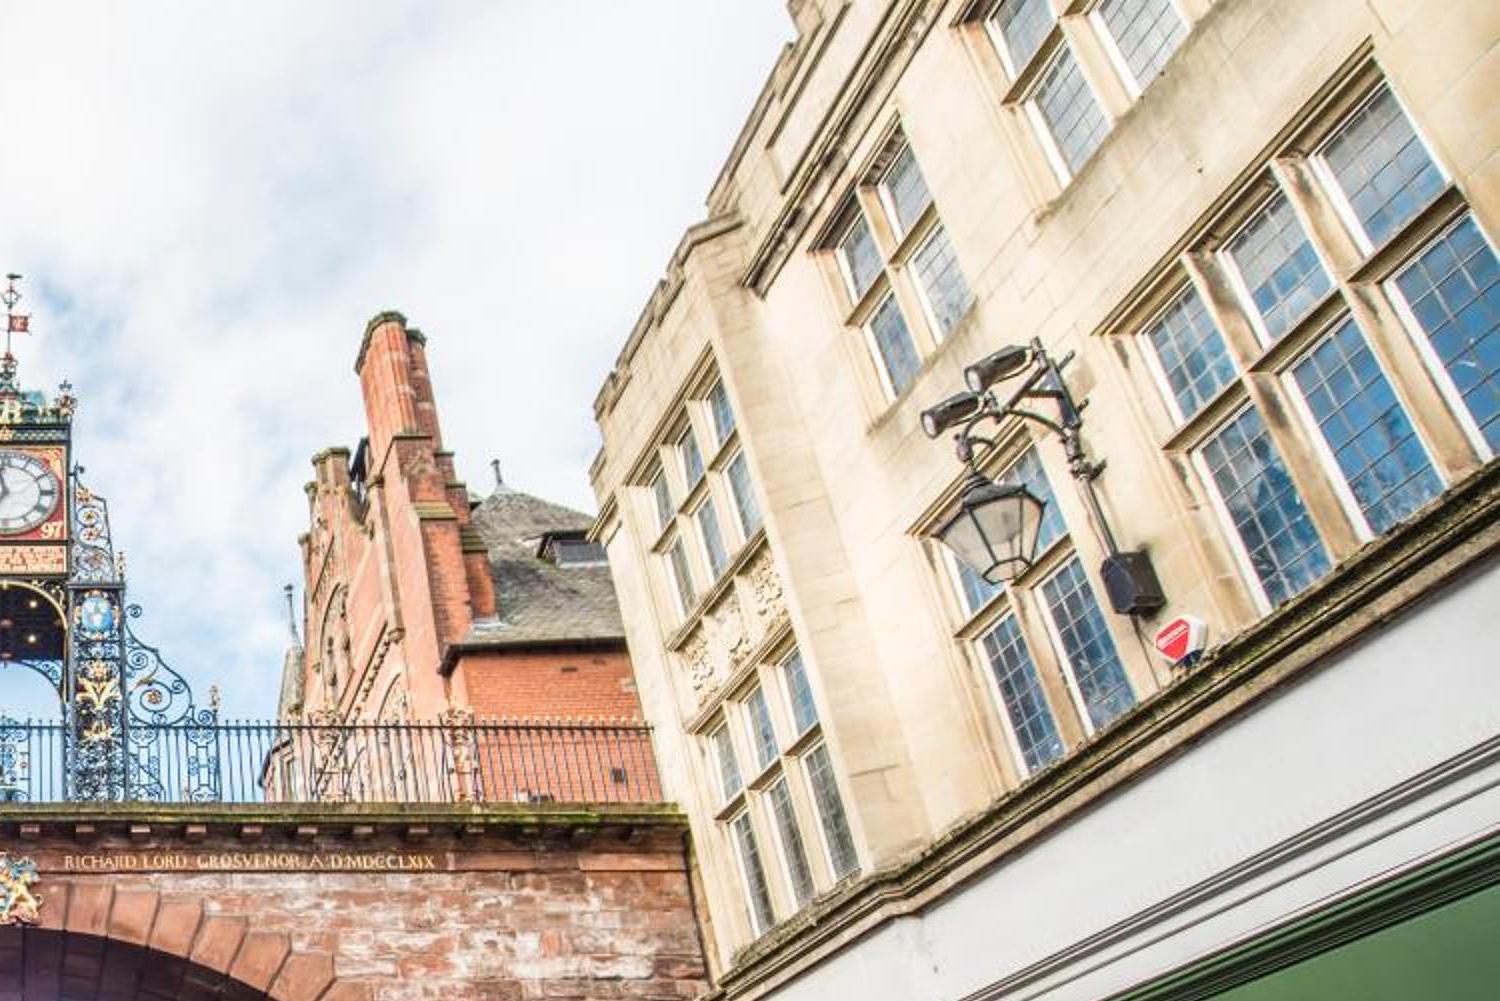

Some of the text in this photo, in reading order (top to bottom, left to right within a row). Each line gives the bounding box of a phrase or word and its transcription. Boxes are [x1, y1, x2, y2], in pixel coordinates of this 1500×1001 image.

[41, 521, 62, 539] 97
[143, 854, 187, 869] LORD
[197, 853, 299, 869] GROSVENOR
